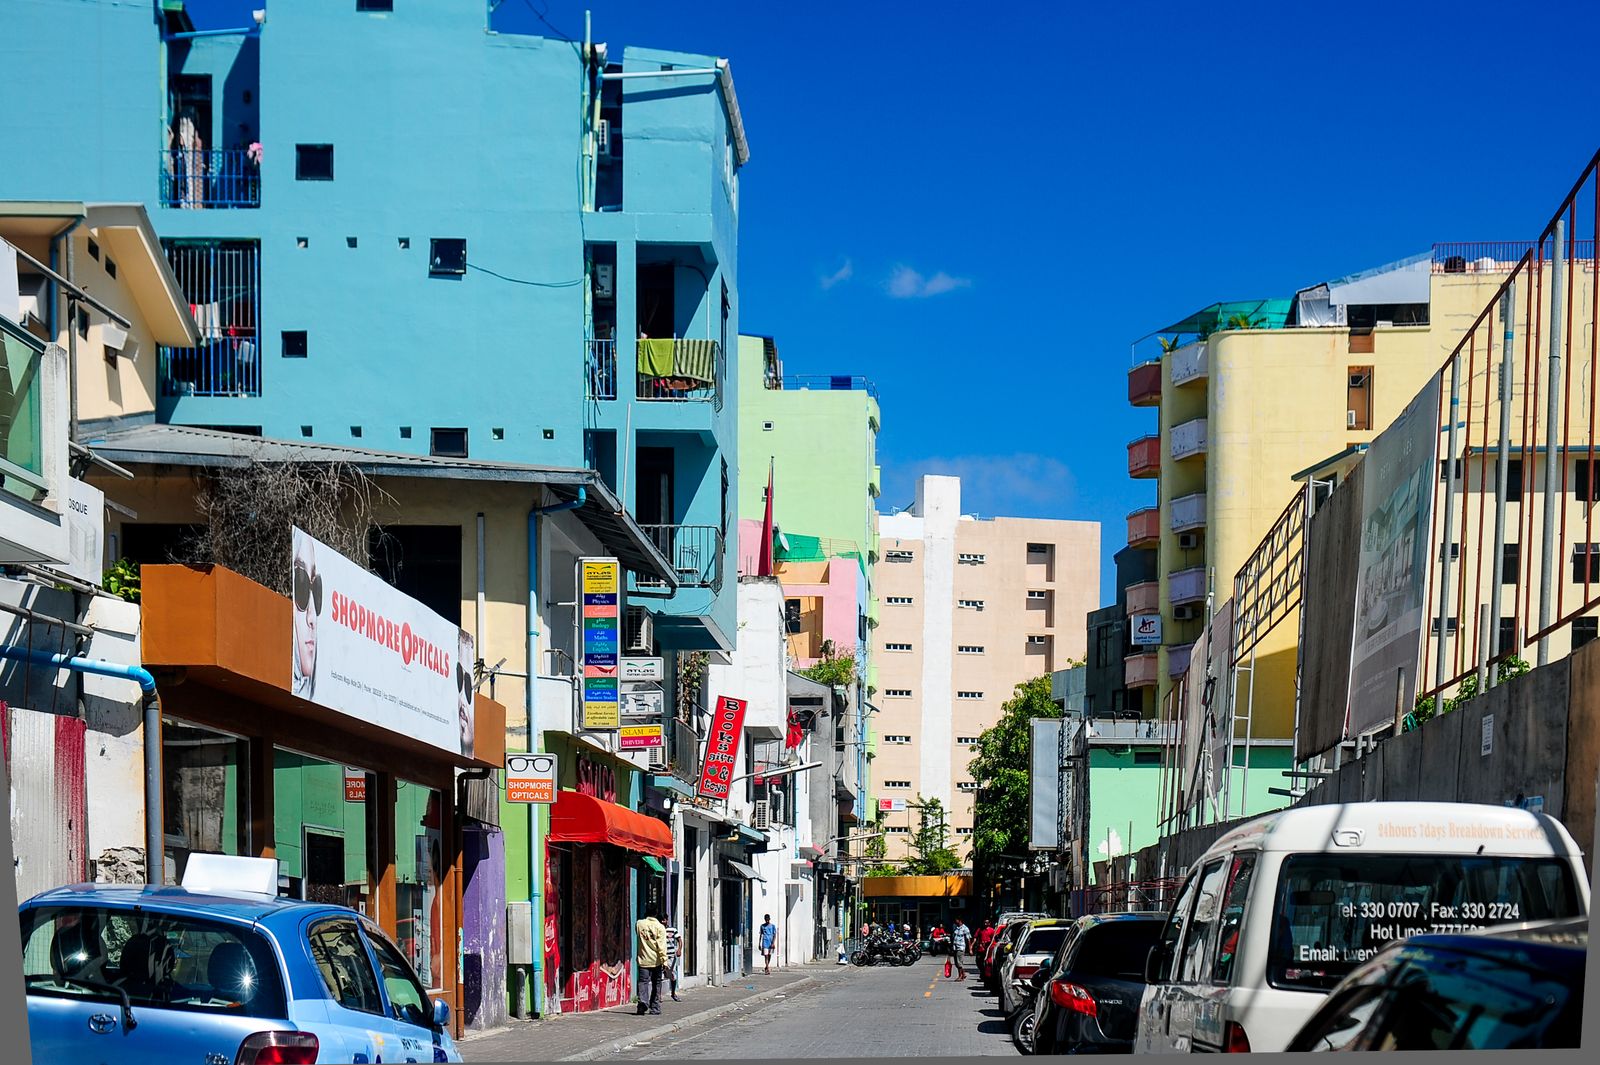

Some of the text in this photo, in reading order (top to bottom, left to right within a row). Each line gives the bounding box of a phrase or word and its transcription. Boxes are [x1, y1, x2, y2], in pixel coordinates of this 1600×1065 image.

[622, 728, 644, 736] ISLAM
[508, 781, 553, 790] SHOPMORE
[703, 779, 728, 794] toys
[511, 791, 549, 800] OPTICALS
[1449, 822, 1503, 839] Breakdown
[1360, 902, 1385, 918] 330
[1387, 902, 1418, 918] 0707
[1431, 902, 1458, 919] Fax:
[1461, 903, 1486, 919] 330
[1488, 903, 1520, 920] 2724
[1370, 924, 1393, 940] Hot
[1299, 945, 1340, 961] Email:
